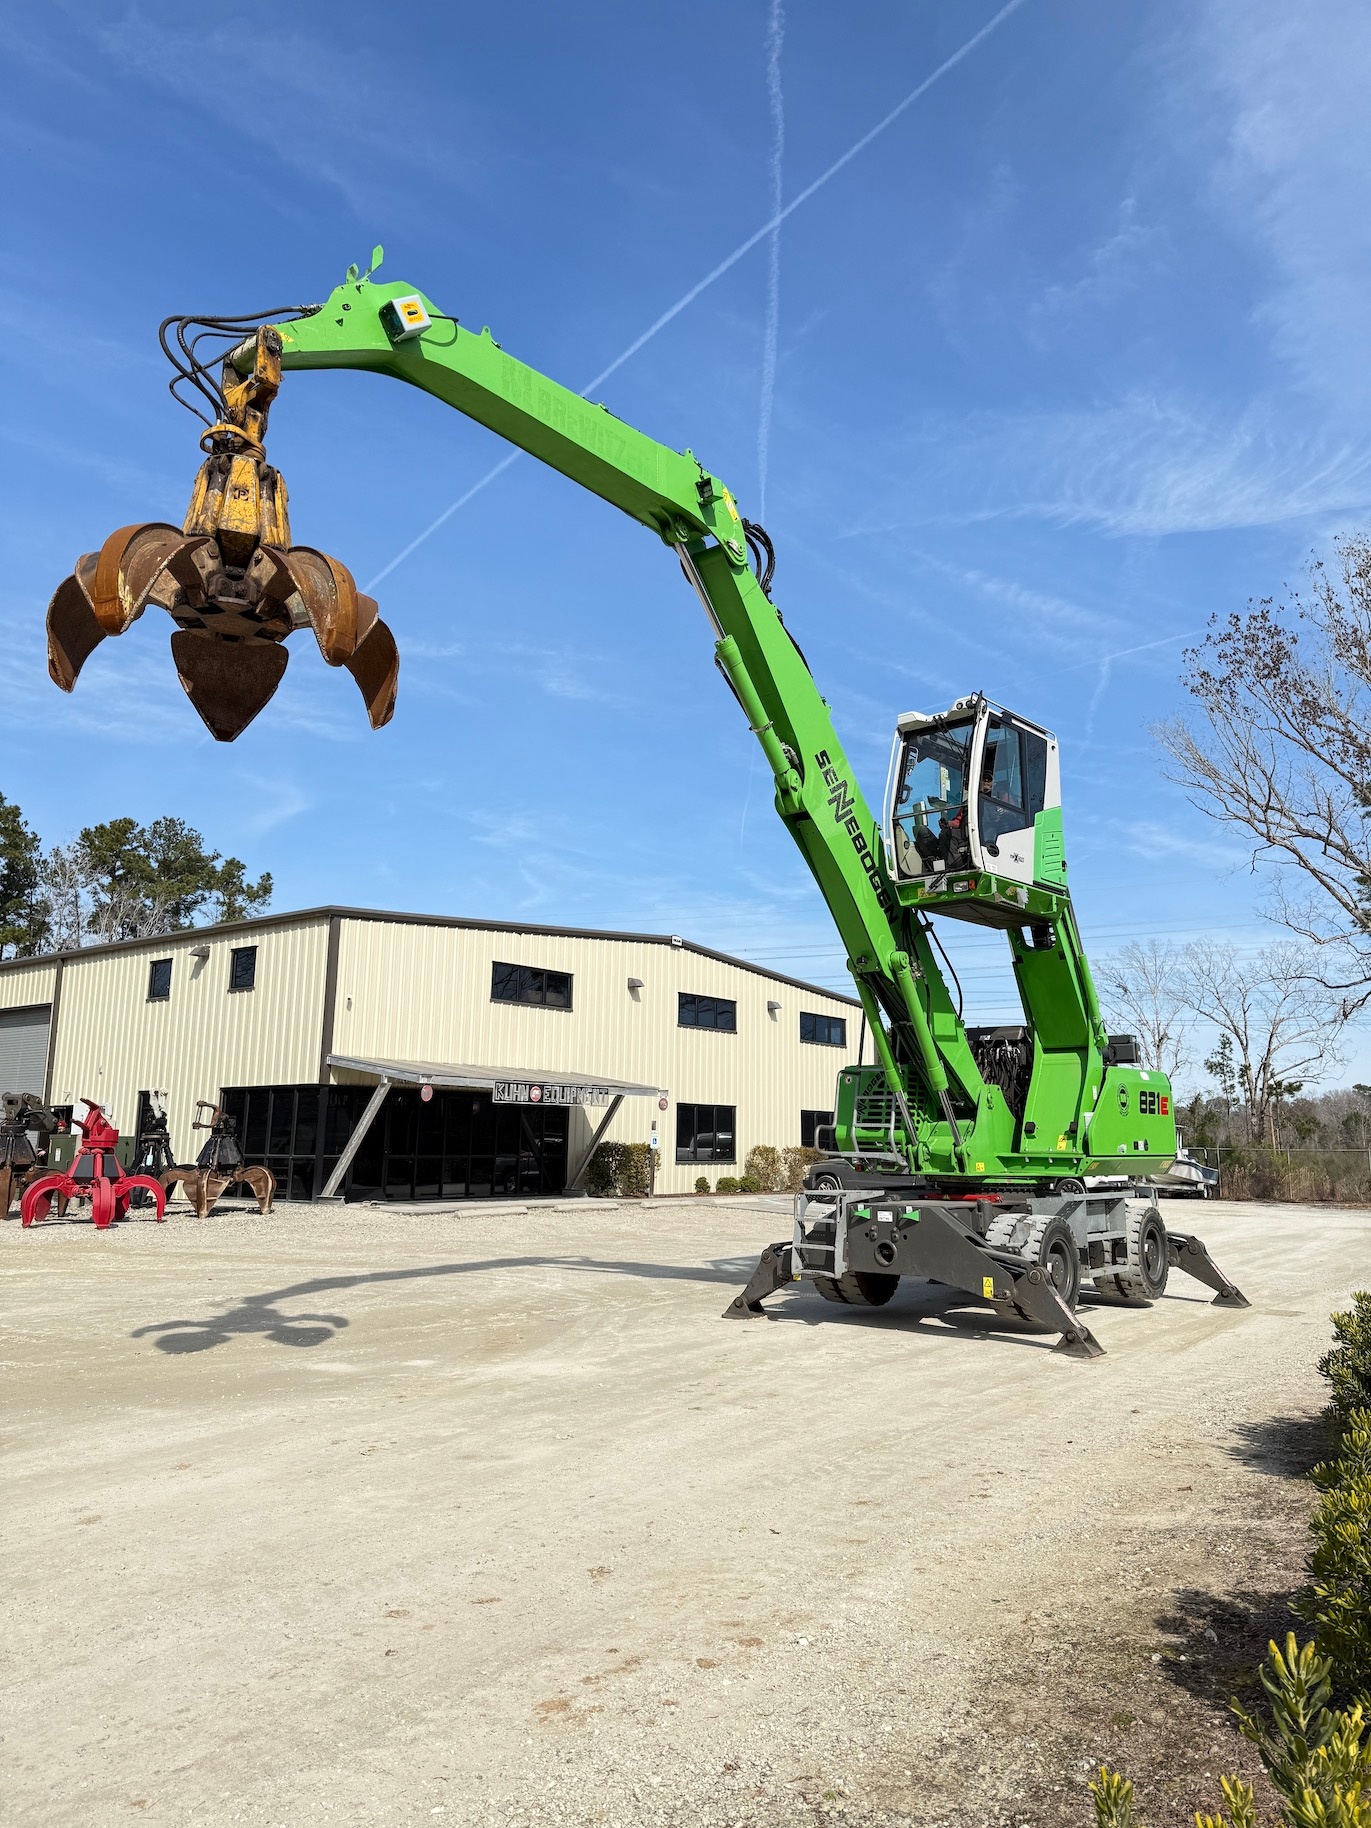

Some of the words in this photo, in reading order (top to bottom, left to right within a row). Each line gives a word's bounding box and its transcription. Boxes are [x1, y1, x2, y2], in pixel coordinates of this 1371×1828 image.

[814, 749, 899, 926] SENEBOGEN
[495, 1082, 529, 1101] KUHN
[543, 1086, 608, 1106] EQUIPMENT
[1140, 1091, 1168, 1115] 821E
